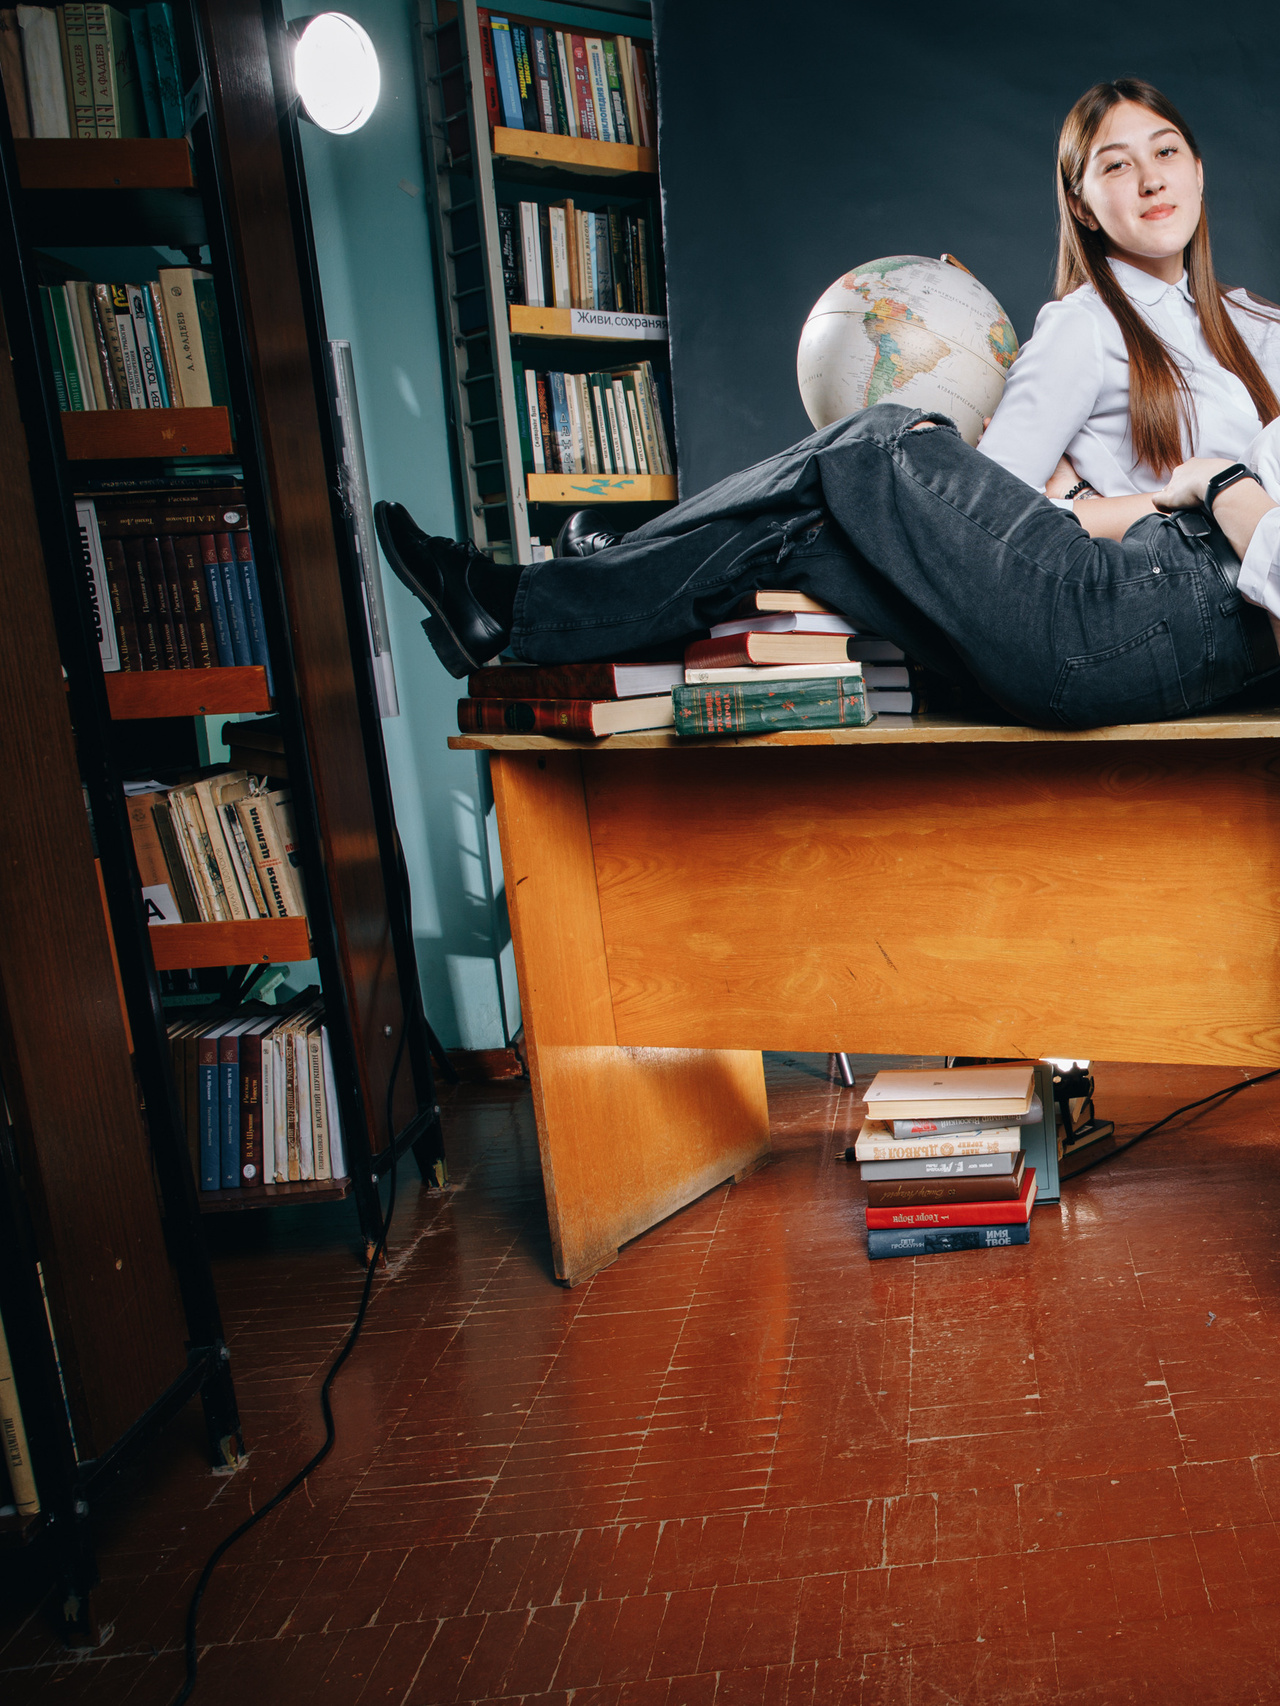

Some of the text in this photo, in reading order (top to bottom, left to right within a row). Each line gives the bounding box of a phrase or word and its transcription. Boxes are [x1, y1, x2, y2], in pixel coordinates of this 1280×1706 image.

[74, 44, 87, 87] ФАДЕЕВ
[95, 43, 108, 86] ФАДЕЕВ
[512, 28, 528, 99] ЭНЦИКЛОПЕДИЯ
[519, 27, 532, 85] ШКОЛЬНИКУ
[536, 39, 546, 64] ДЕВОЧЕК
[586, 99, 599, 140] РЕСТОМАТИЯ
[597, 86, 612, 142] НЦИКЛОПЕДИЯ
[586, 251, 594, 294] ЧЕТВЕРТАЯ
[577, 311, 668, 330] Живи, сохраняя
[118, 324, 129, 350] ТРИЛОГИЯ
[129, 350, 142, 395] СТИХОТВОРЕНИЯ
[143, 346, 162, 408] СЕЙ ТОЛСТОЙ
[54, 371, 67, 412] ОНВИЗИН
[68, 372, 82, 412] ОНВИЗИН
[601, 433, 609, 459] МИХАИЛ
[613, 435, 621, 460] МИХАИЛ
[636, 436, 644, 462] МИХАИЛ
[120, 518, 133, 526] Дон
[134, 517, 154, 525] Тихий
[165, 515, 195, 524] Шолохов
[158, 584, 167, 613] Рассказы
[173, 583, 182, 613] Рассказы
[193, 595, 203, 612] Тихий
[119, 626, 130, 653] Шолохов
[147, 623, 157, 652] Шолохов
[162, 624, 173, 652] Шолохов
[177, 624, 188, 652] Шолохов
[199, 622, 209, 651] Шолохов
[714, 690, 724, 732] РУССКОГО
[724, 693, 733, 729] НАРОДА
[249, 807, 270, 859] ЦЕЛИНА
[226, 884, 240, 916] МИХАИЛ
[266, 867, 287, 917] ДНЯТАЯ
[144, 899, 166, 923] А
[313, 1055, 322, 1092] ШУКШИН
[250, 1079, 258, 1104] Повести
[315, 1093, 323, 1129] ВАСИЛИЙ
[941, 1116, 980, 1129] Высоцкий
[246, 1113, 254, 1140] Шукшин
[888, 1144, 938, 1159] ДЬЯВОЛ
[892, 1213, 939, 1223] Георг Борн
[891, 1242, 925, 1250] ПРОСКУРИН
[985, 1237, 1012, 1246] ТВОЕ
[986, 1229, 1008, 1239] ИМЯ
